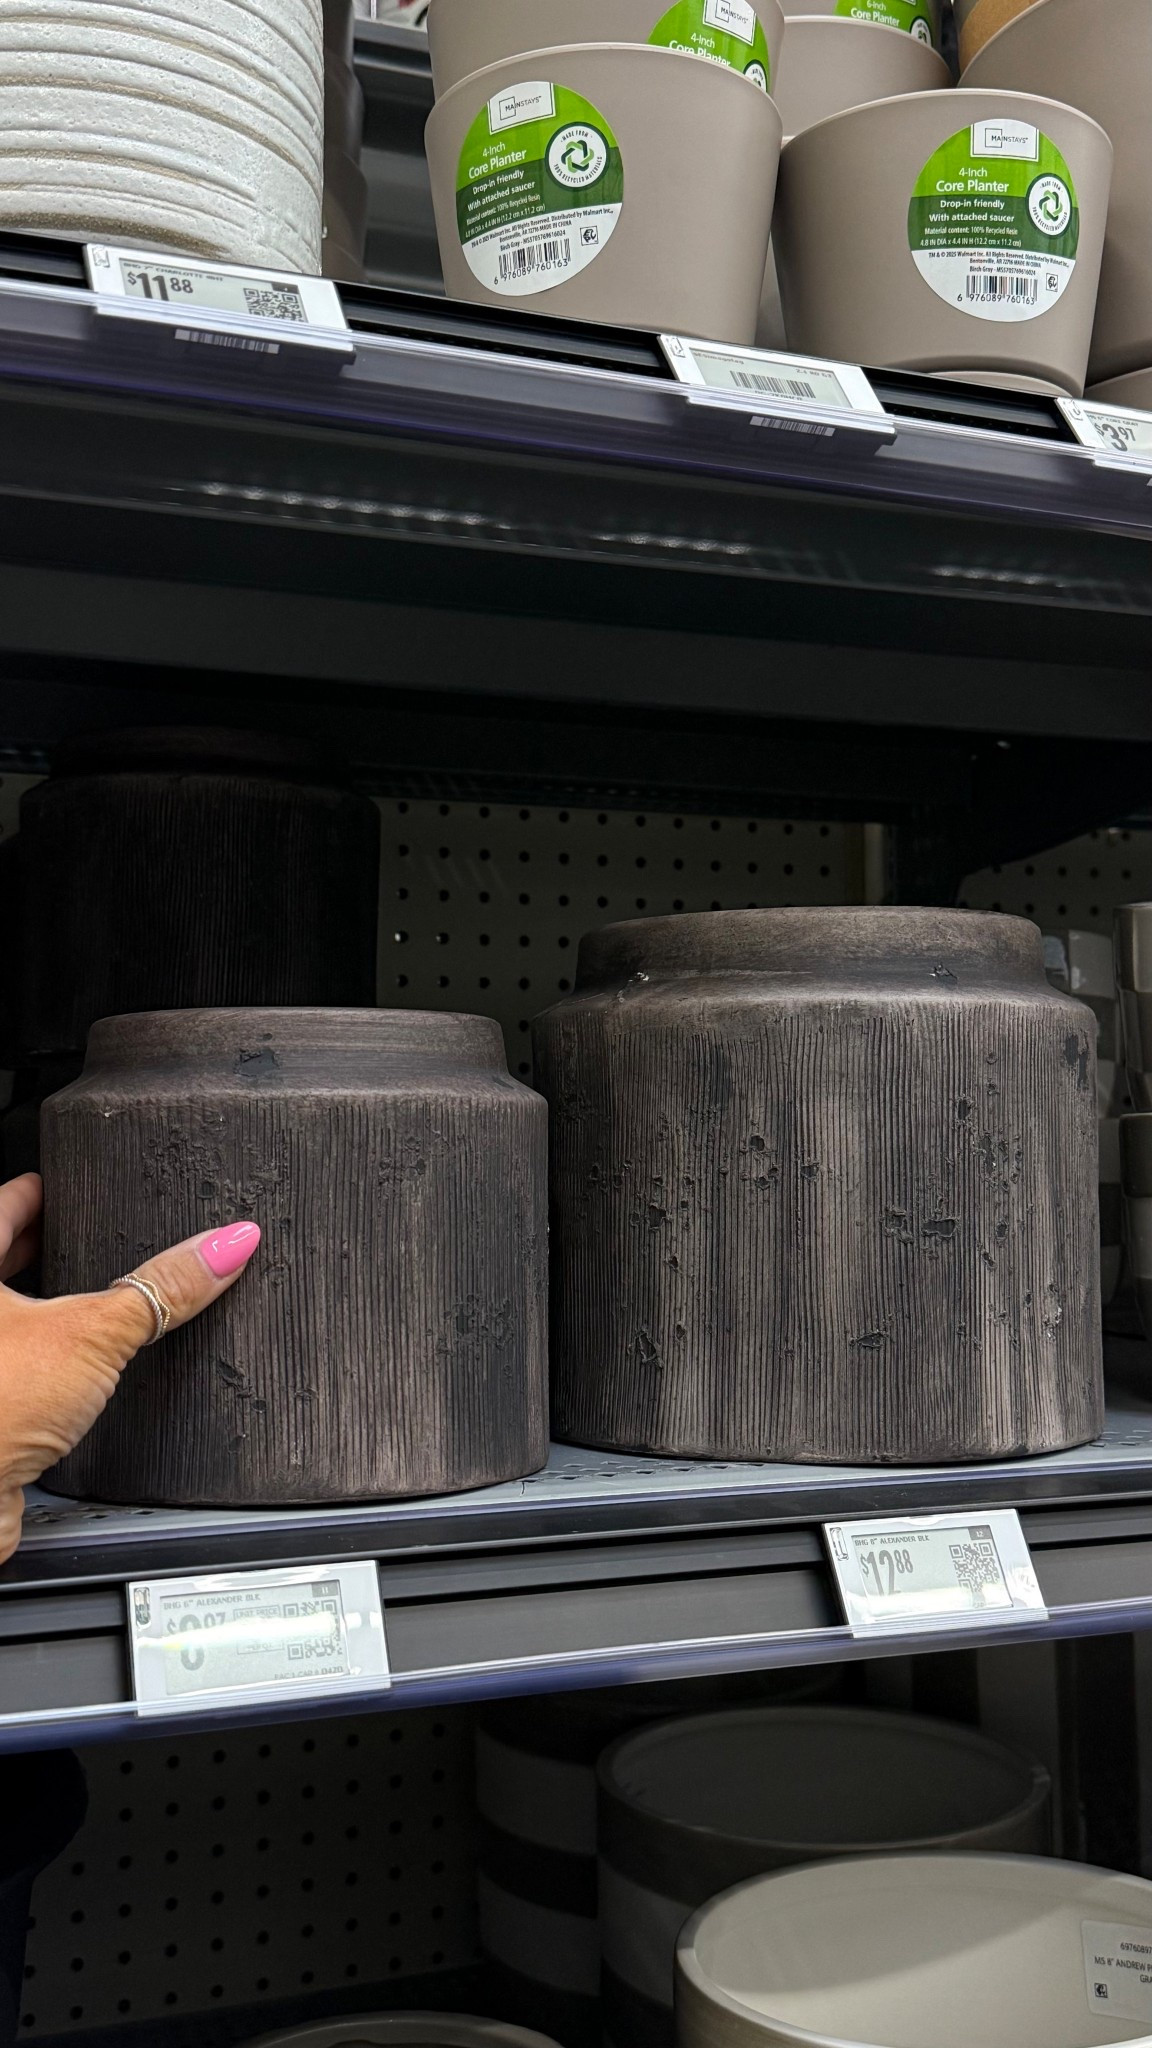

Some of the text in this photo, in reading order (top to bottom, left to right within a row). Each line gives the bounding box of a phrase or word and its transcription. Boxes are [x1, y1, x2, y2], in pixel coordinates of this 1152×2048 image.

[851, 8, 900, 26] Core Planter
[669, 40, 731, 66] Core Planter
[482, 142, 506, 157] 4-Inch
[468, 150, 526, 178] Core Planter
[959, 168, 988, 177] 4-Inch
[472, 170, 524, 195] Drop-in friendly
[936, 180, 1009, 192] Core Planter
[468, 182, 536, 212] With attached saucer
[940, 200, 1005, 209] Drop-in friendly
[929, 213, 1014, 222] With attached saucer
[494, 258, 568, 285] 6 976089 760163
[970, 294, 1002, 302] 976089
[1006, 294, 1035, 305] 760163
[880, 1536, 916, 1544] ALEXANDER
[197, 1595, 243, 1607] ALEXANDER
[1094, 1956, 1105, 1965] MS
[1116, 1959, 1146, 1972] ANDREW
